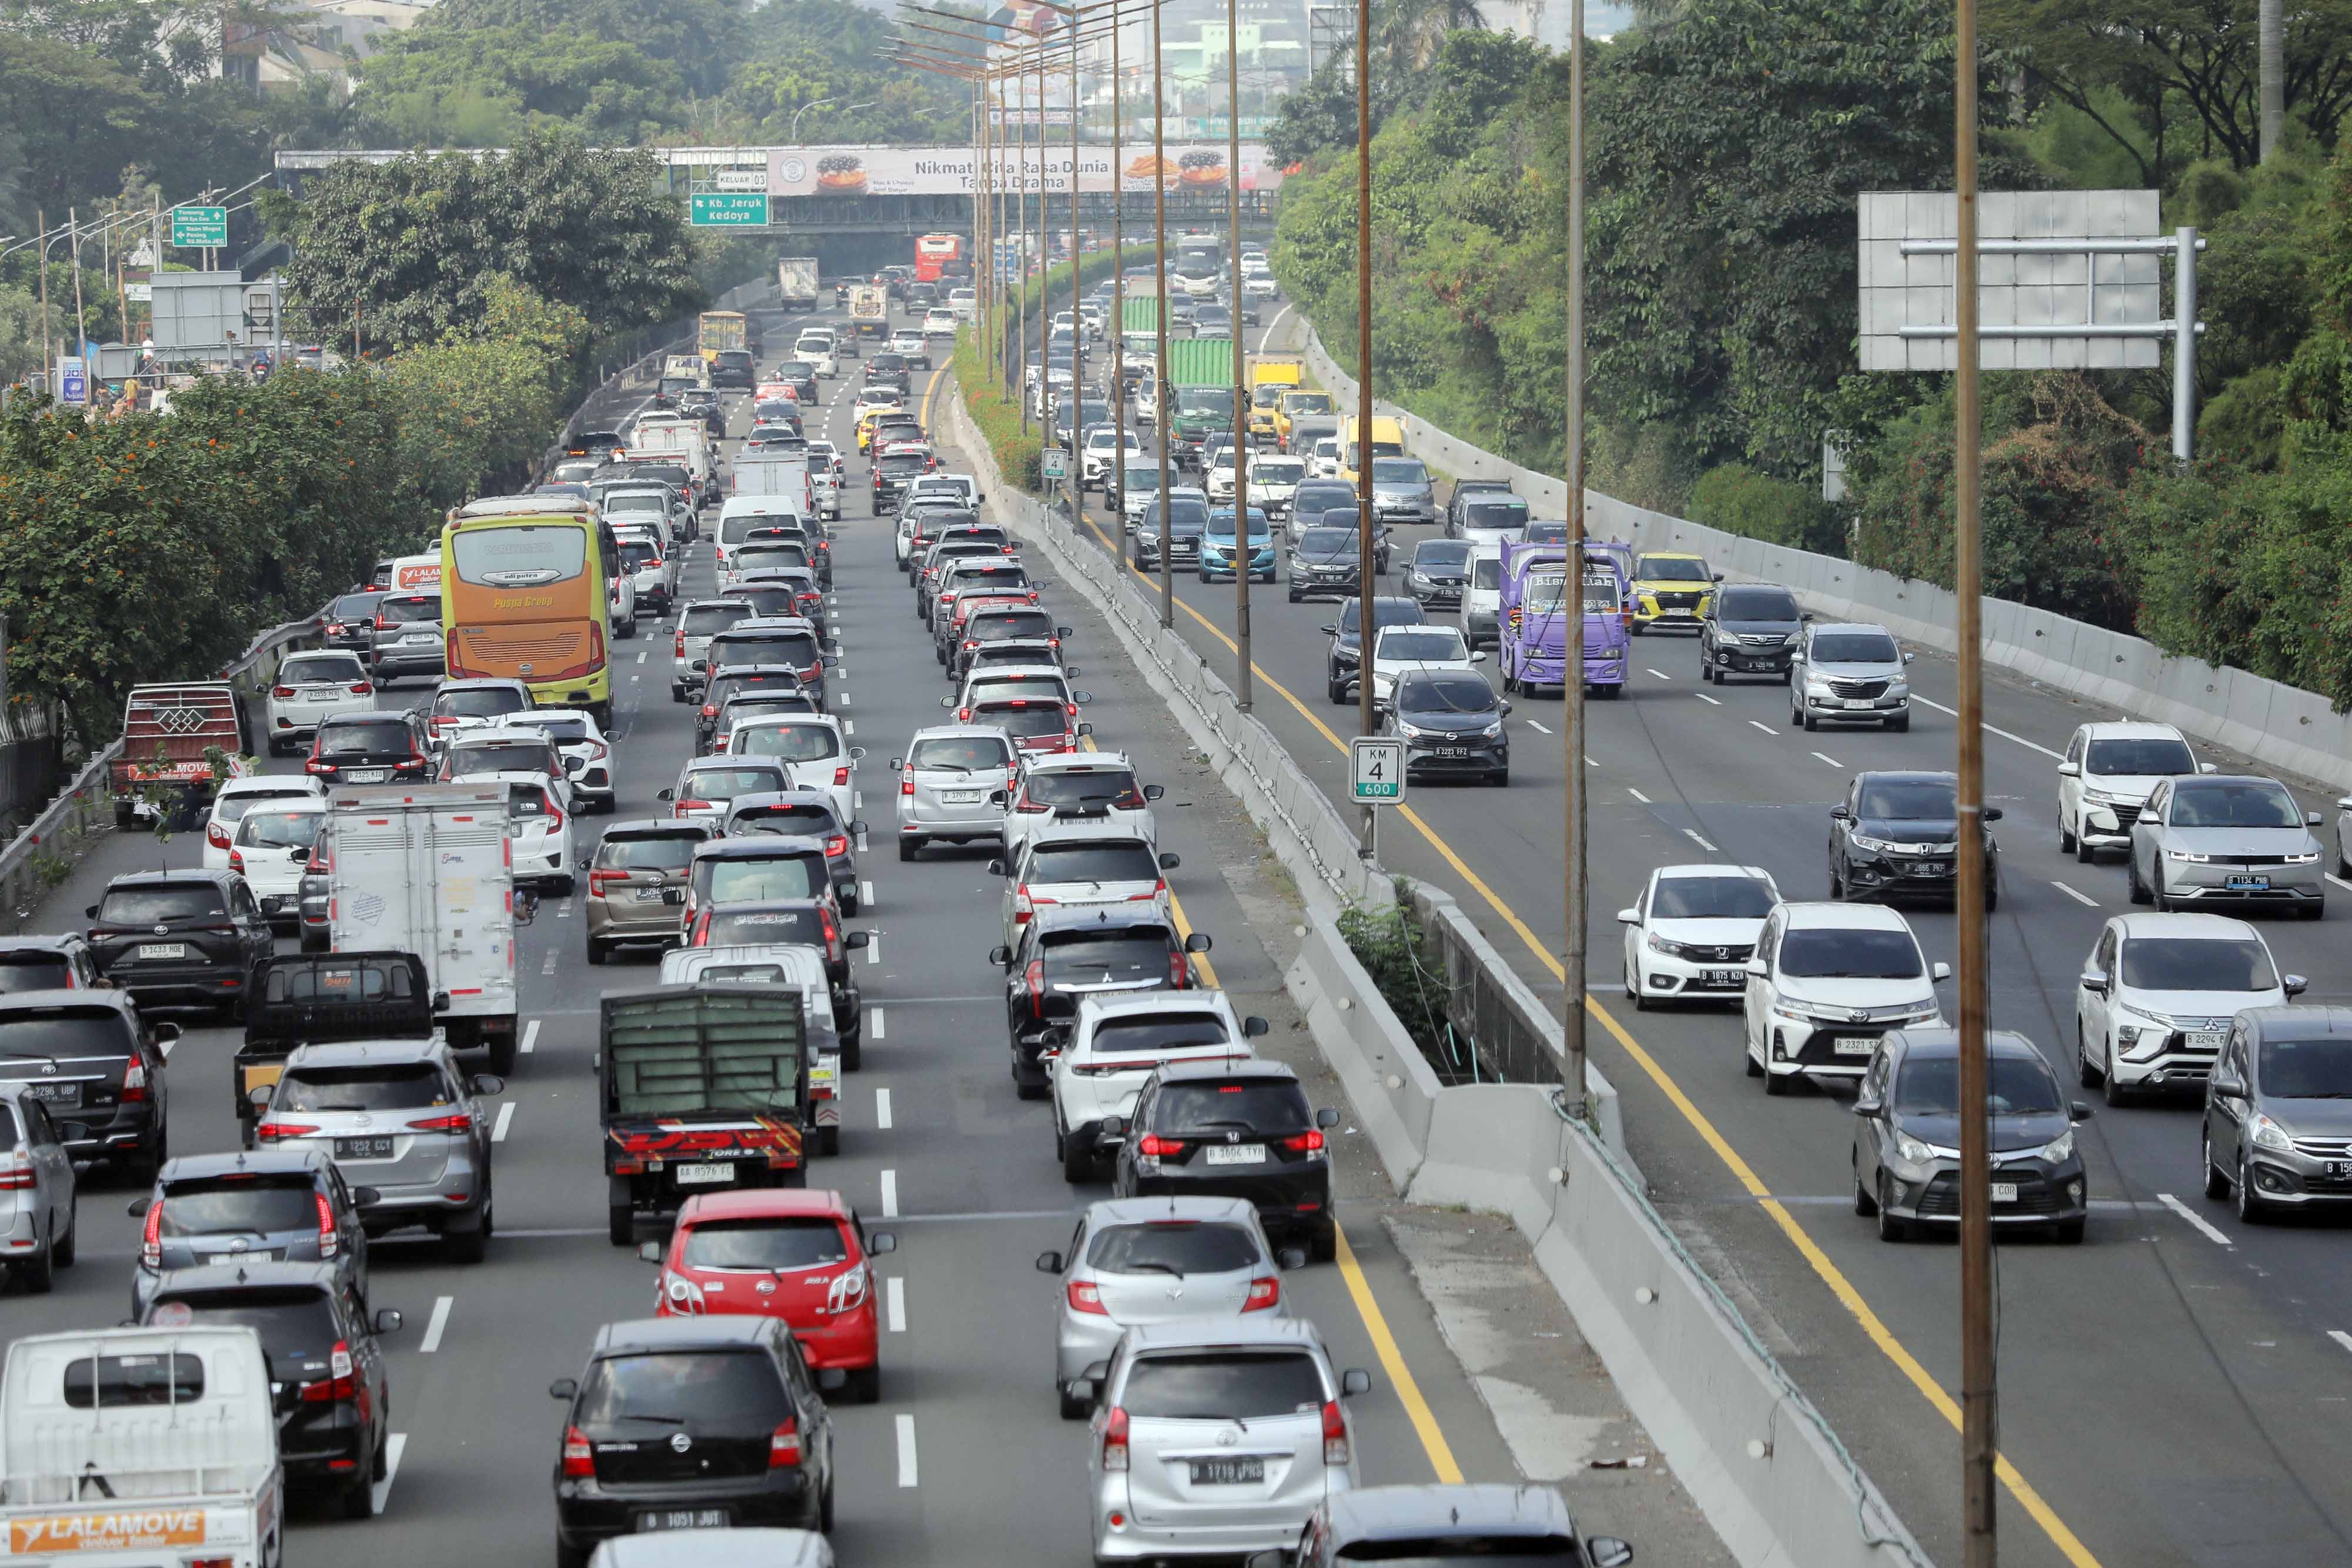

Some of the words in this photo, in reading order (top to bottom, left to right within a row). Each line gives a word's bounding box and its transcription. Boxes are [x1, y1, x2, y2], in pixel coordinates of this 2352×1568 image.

[915, 161, 974, 174] Nikmat
[1022, 160, 1058, 173] Rasa
[1063, 160, 1109, 173] Dunia
[754, 175, 765, 184] 03
[1012, 176, 1065, 188] Drama
[731, 199, 762, 208] Jeruk
[709, 212, 750, 221] Kedoya
[1051, 460, 1058, 469] 4
[494, 598, 522, 609] Puspa
[526, 595, 554, 608] Group
[1370, 750, 1387, 759] KM
[1369, 762, 1383, 780] 4
[1365, 784, 1390, 794] 600
[2196, 1035, 2215, 1044] 2294
[36, 1086, 55, 1095] 2296
[61, 1085, 77, 1095] UBP
[336, 1142, 343, 1153] B
[1209, 1148, 1215, 1158] B
[2328, 1163, 2333, 1172] B
[50, 1512, 199, 1539] LALAMOVE
[78, 1534, 126, 1549] deliver
[129, 1533, 167, 1547] faster
